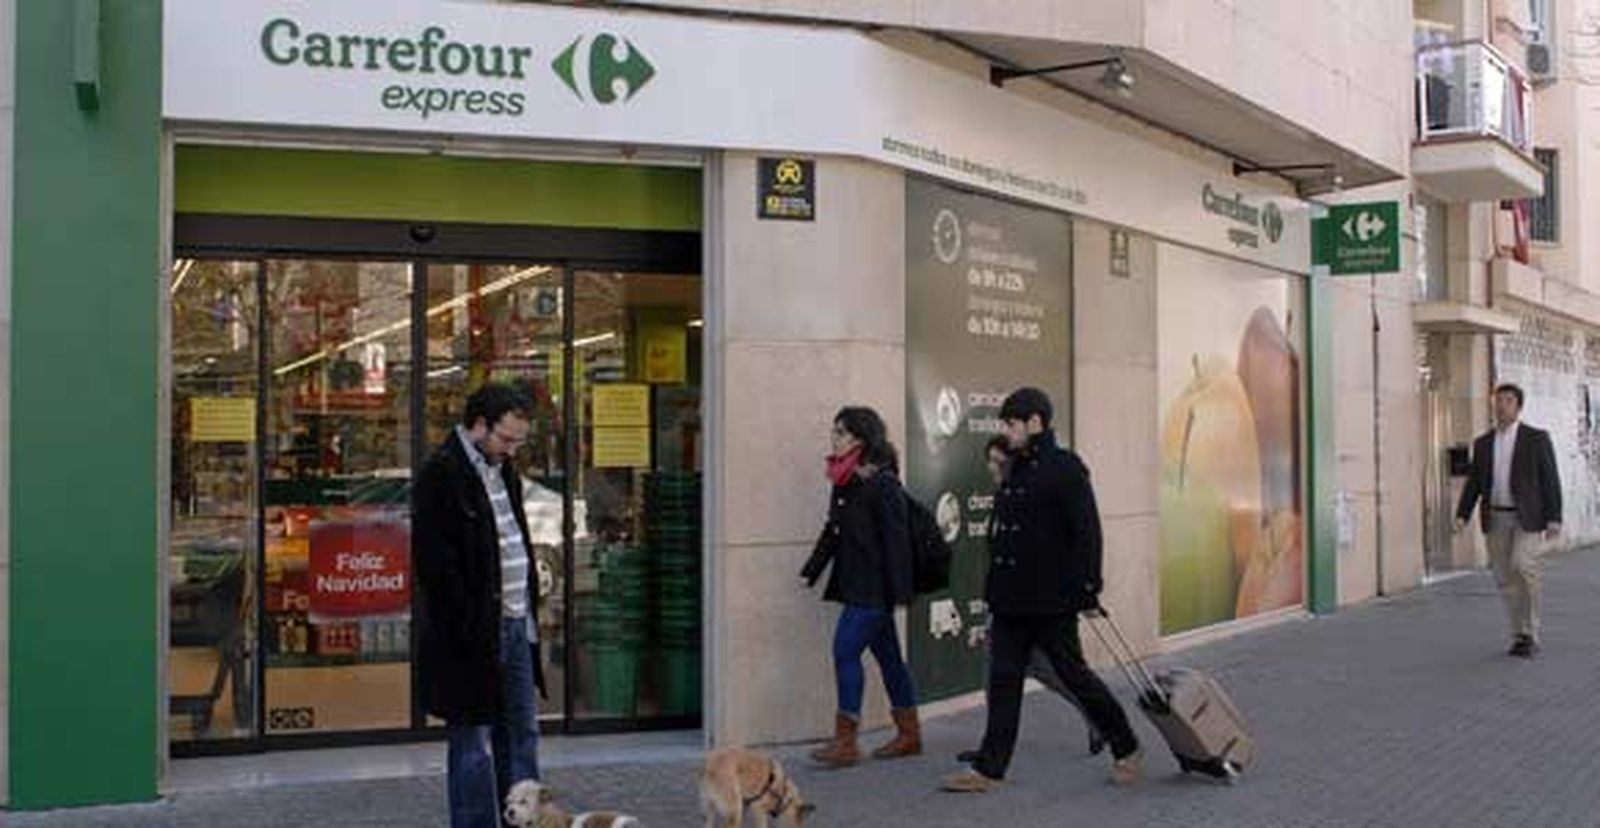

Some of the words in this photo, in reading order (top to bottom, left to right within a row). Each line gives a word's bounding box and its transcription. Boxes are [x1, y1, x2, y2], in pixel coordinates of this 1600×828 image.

[261, 18, 532, 79] Carrefour
[381, 84, 526, 118] express
[335, 552, 385, 572] Feliz
[317, 573, 404, 592] Navidad
